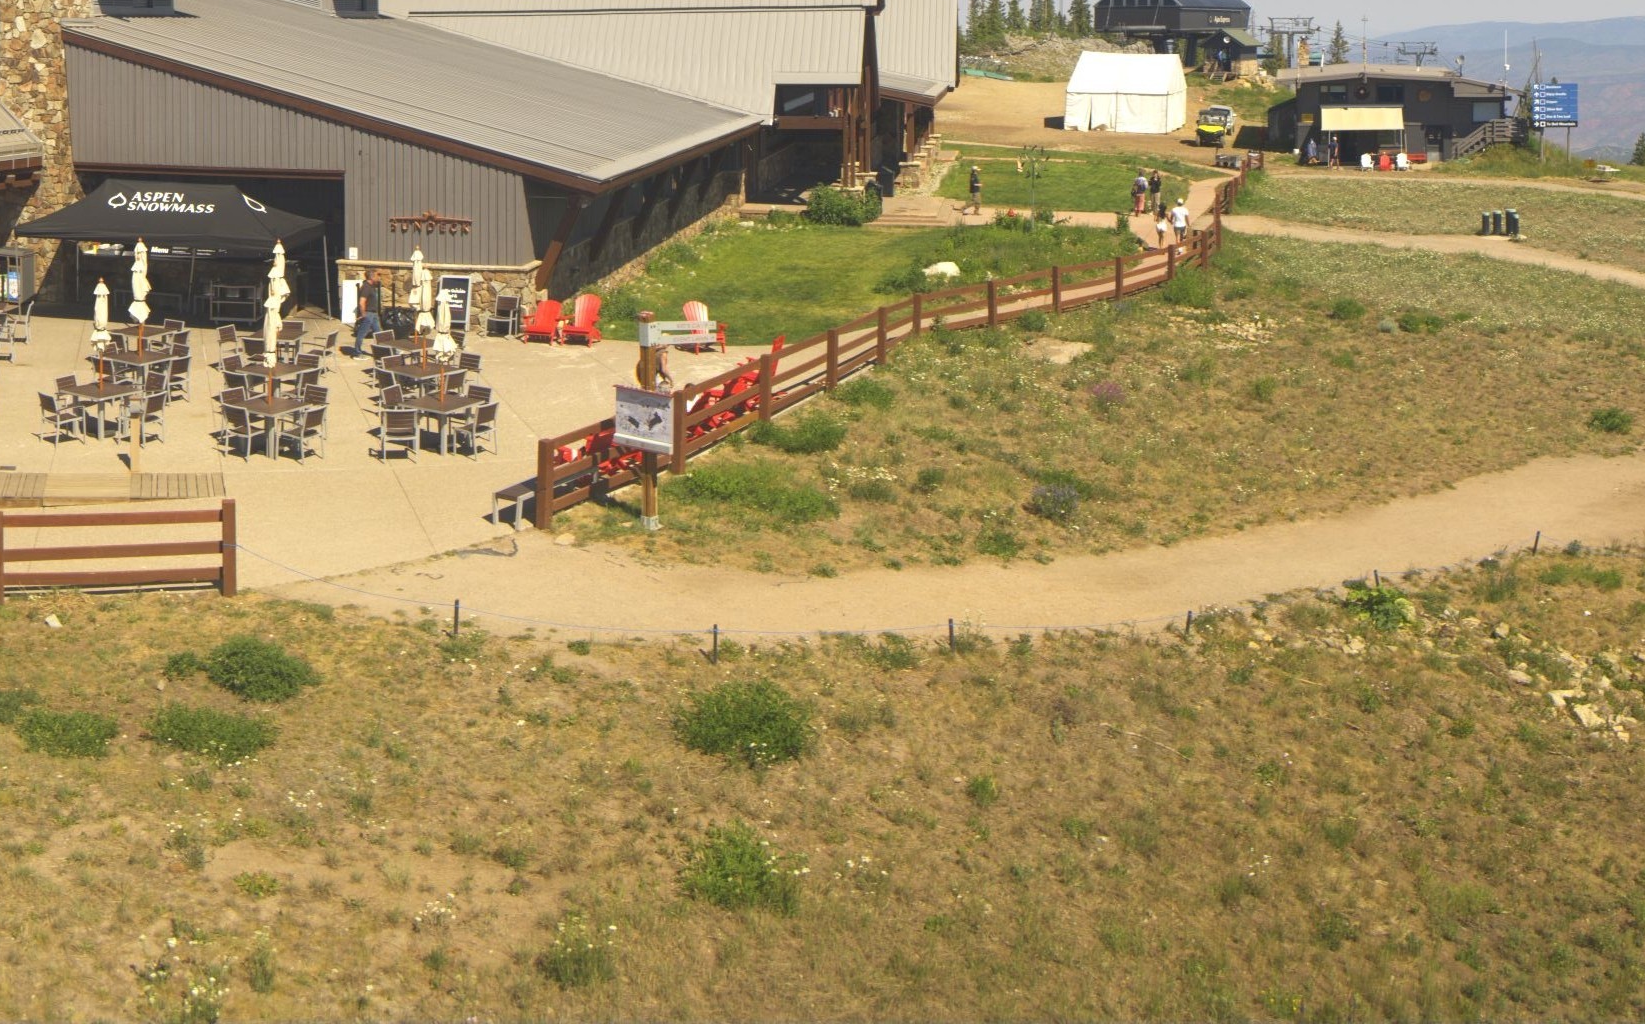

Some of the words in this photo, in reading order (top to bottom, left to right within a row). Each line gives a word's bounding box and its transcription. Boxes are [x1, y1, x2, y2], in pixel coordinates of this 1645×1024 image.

[131, 191, 184, 203] ASPEN
[127, 201, 215, 214] SNOWMASS
[390, 220, 470, 235] SUNDECK
[150, 246, 169, 254] Menu
